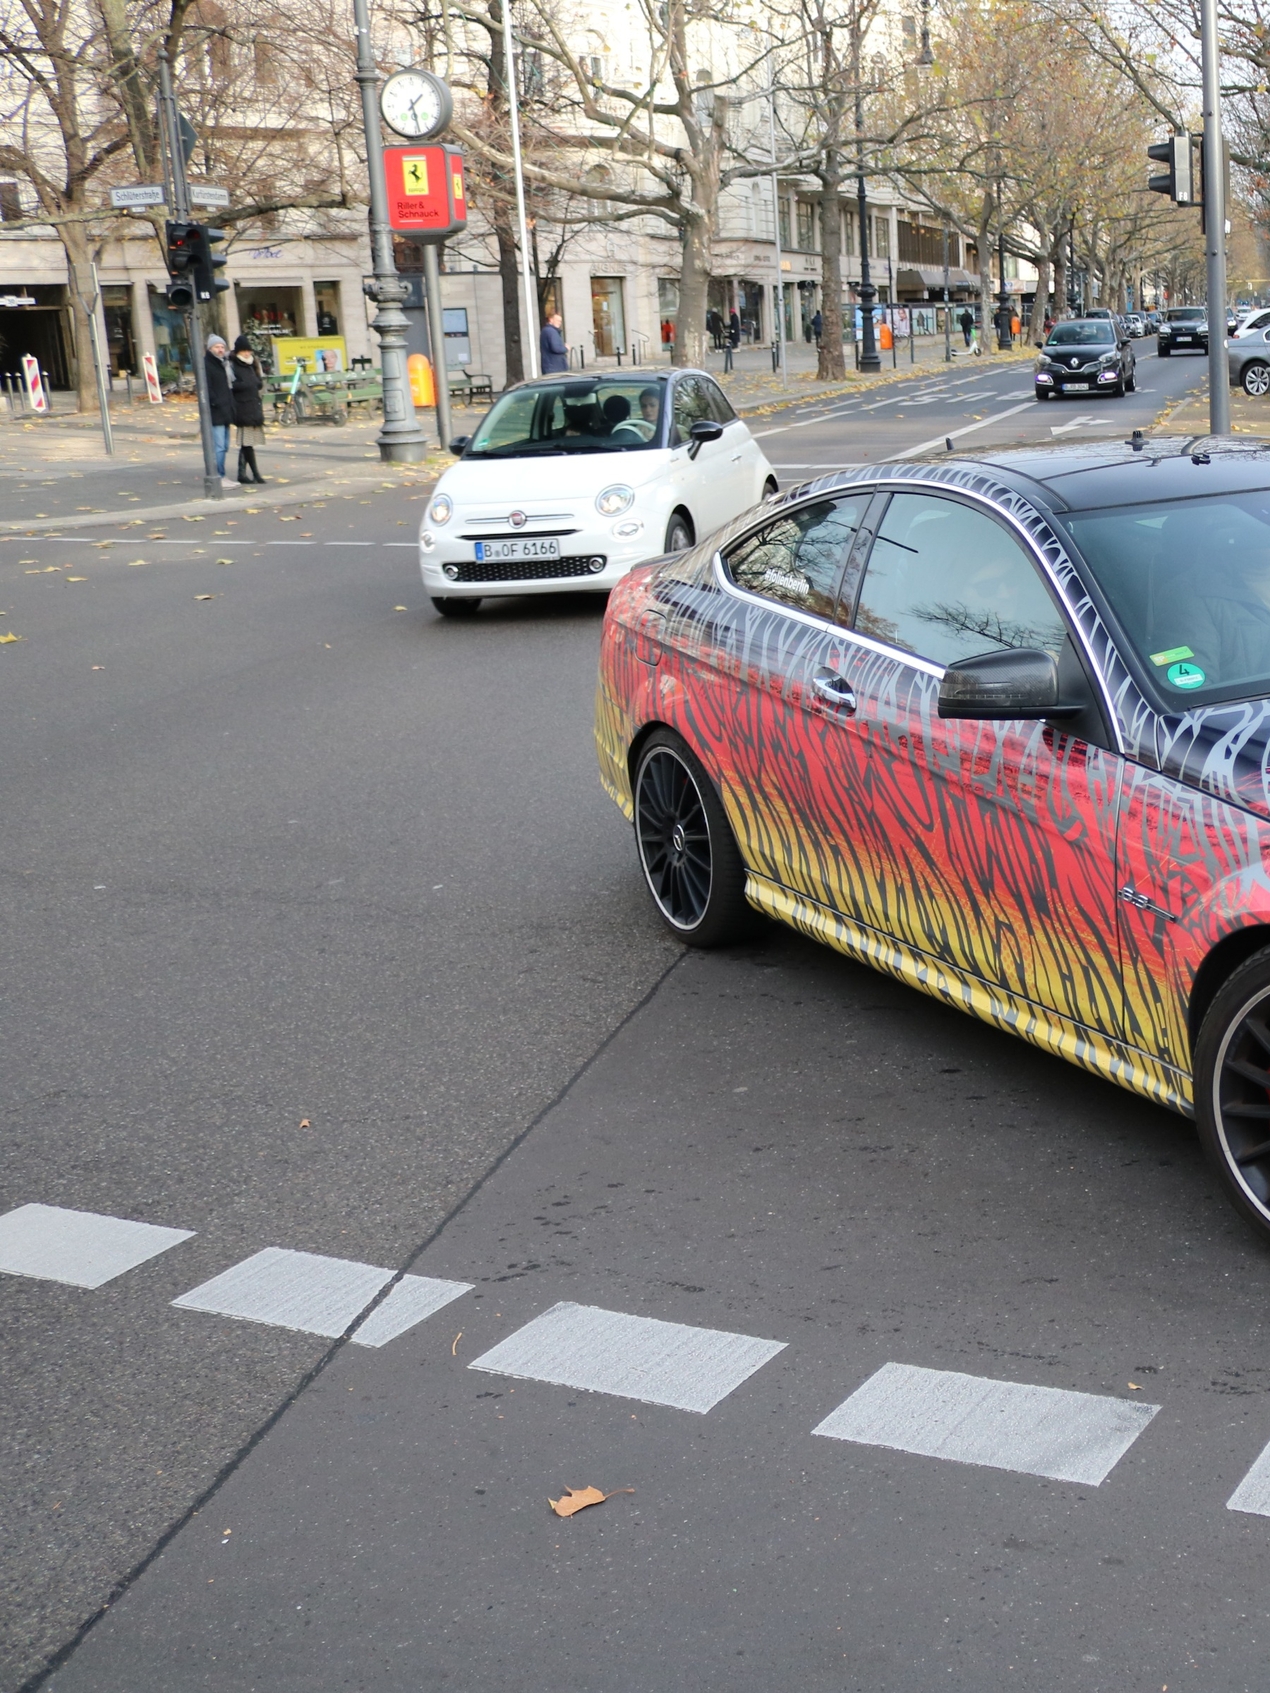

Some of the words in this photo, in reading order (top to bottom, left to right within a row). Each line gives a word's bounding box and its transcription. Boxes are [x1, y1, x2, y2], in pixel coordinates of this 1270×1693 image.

[1179, 192, 1188, 201] F8
[397, 201, 418, 210] Riller
[418, 201, 425, 209] &
[398, 209, 440, 219] Schnauck
[484, 544, 493, 558] B
[501, 543, 518, 557] OF
[523, 541, 557, 556] 6166
[764, 568, 810, 595] #folienberlin
[1179, 664, 1190, 675] 4
